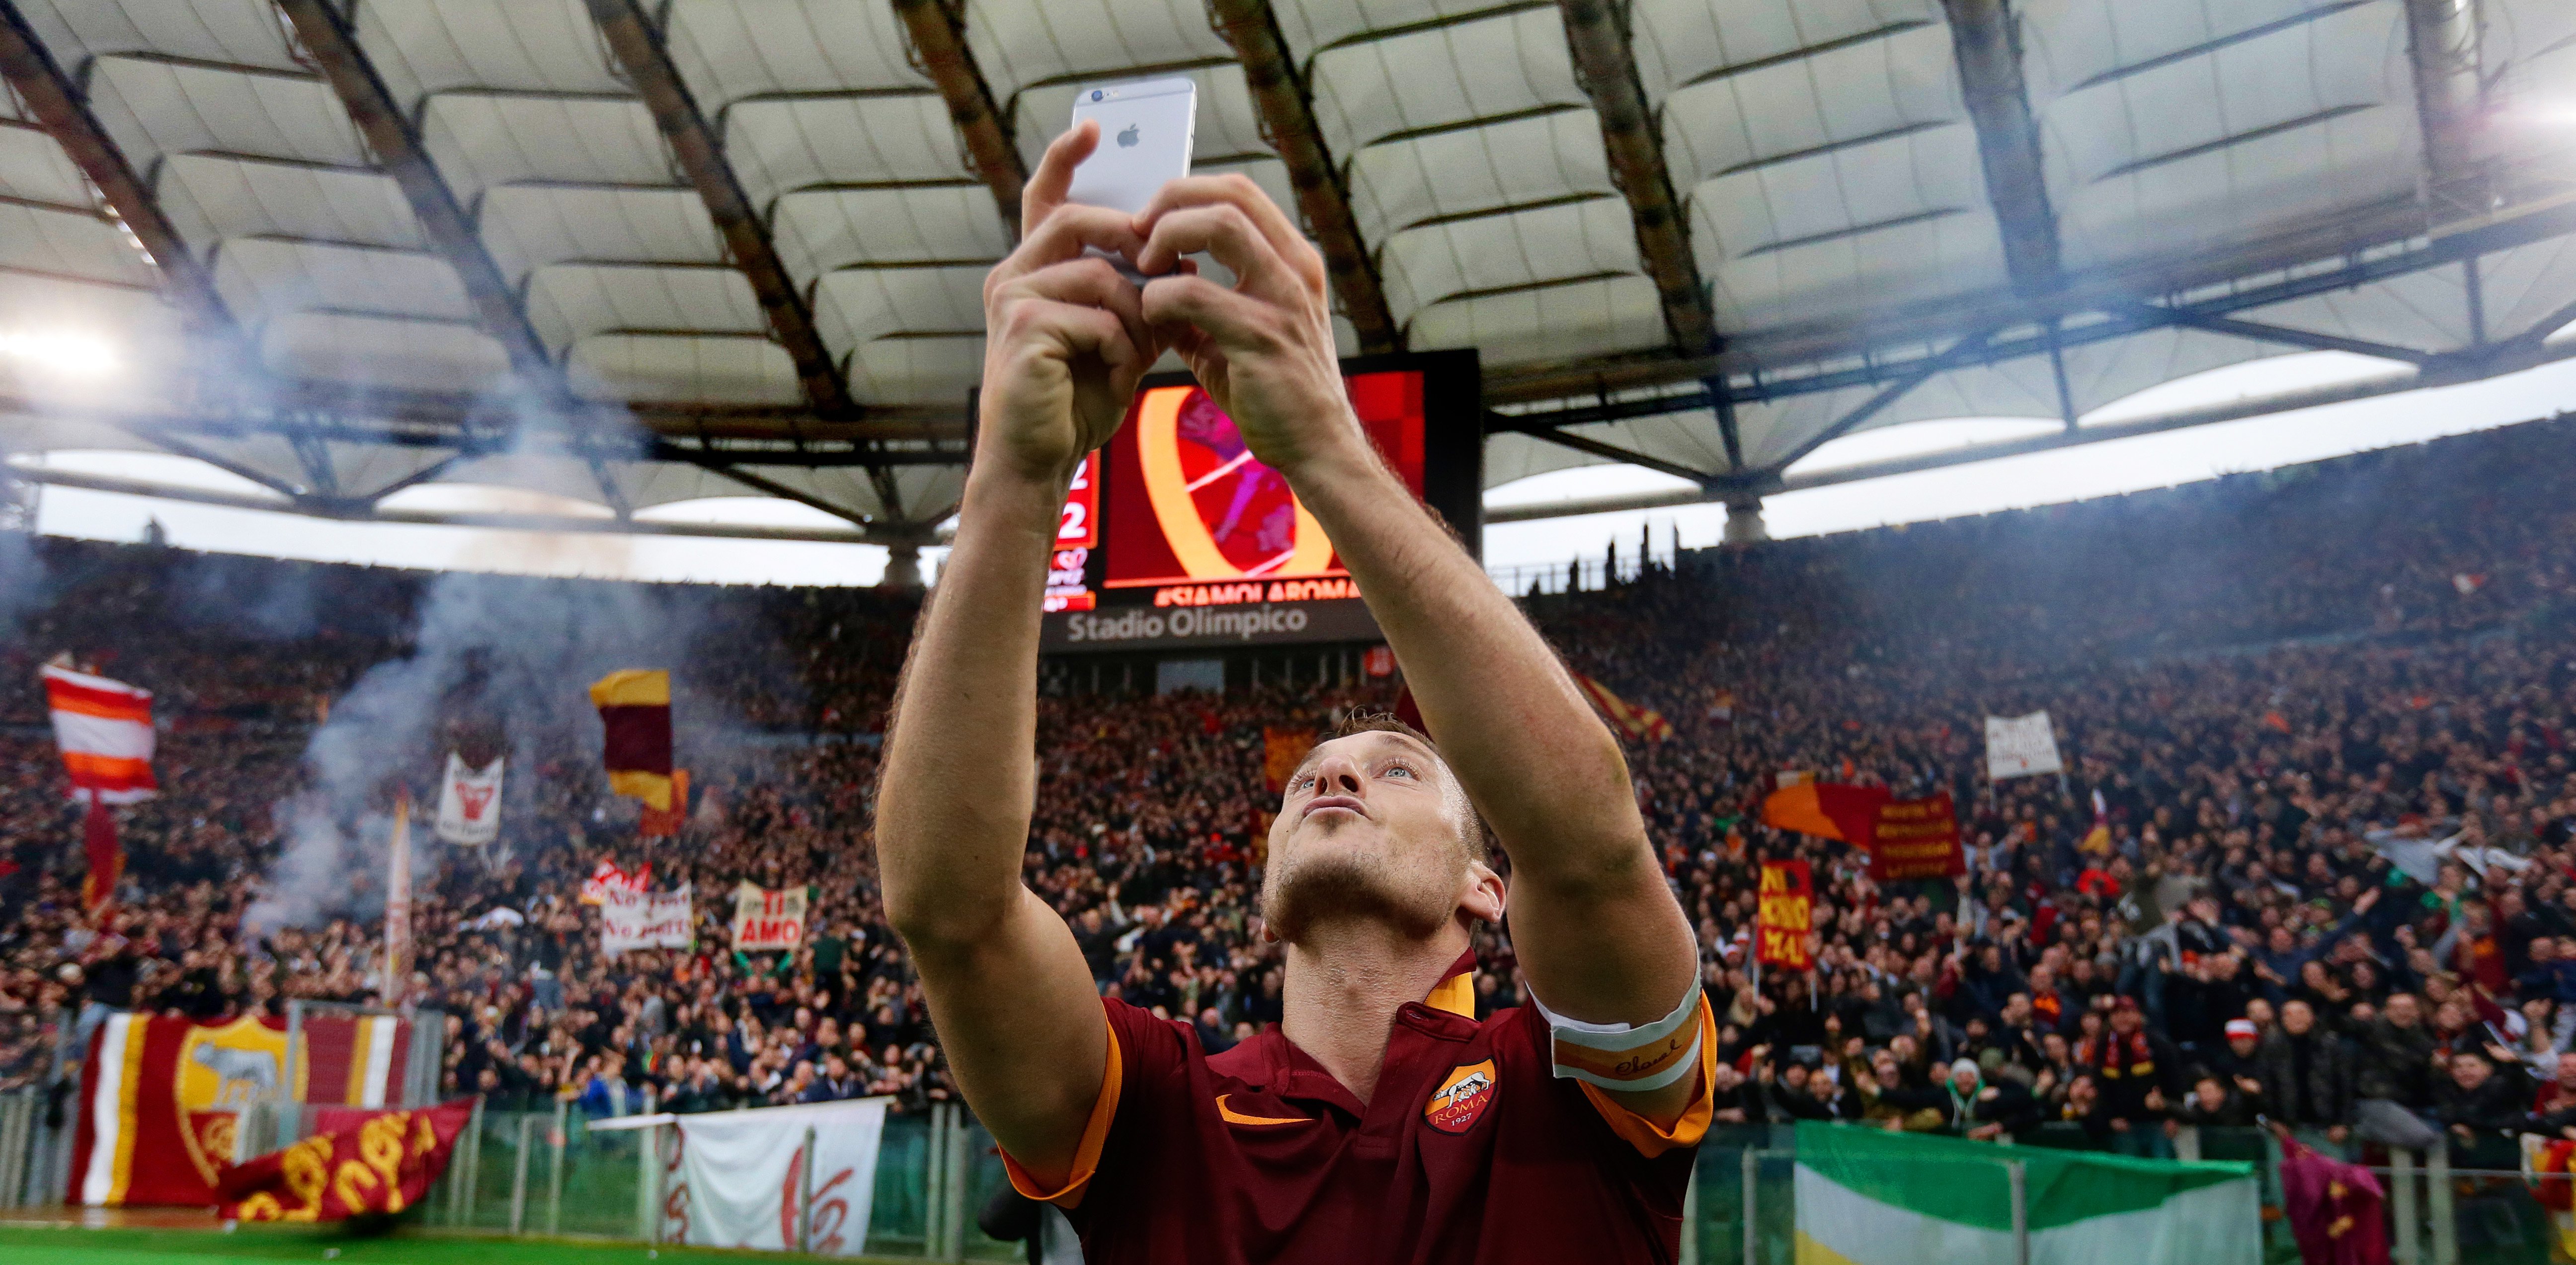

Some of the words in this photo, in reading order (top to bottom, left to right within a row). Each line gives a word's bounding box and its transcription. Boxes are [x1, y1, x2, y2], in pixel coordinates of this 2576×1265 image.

[1058, 502, 1088, 539] 2
[1067, 610, 1164, 642] Stadio
[1168, 603, 1307, 640] Olimpico
[763, 889, 784, 916] TI
[605, 919, 632, 936] No
[740, 917, 801, 943] AMO
[1435, 1095, 1488, 1125] ROMA
[1451, 1112, 1472, 1126] 1927
